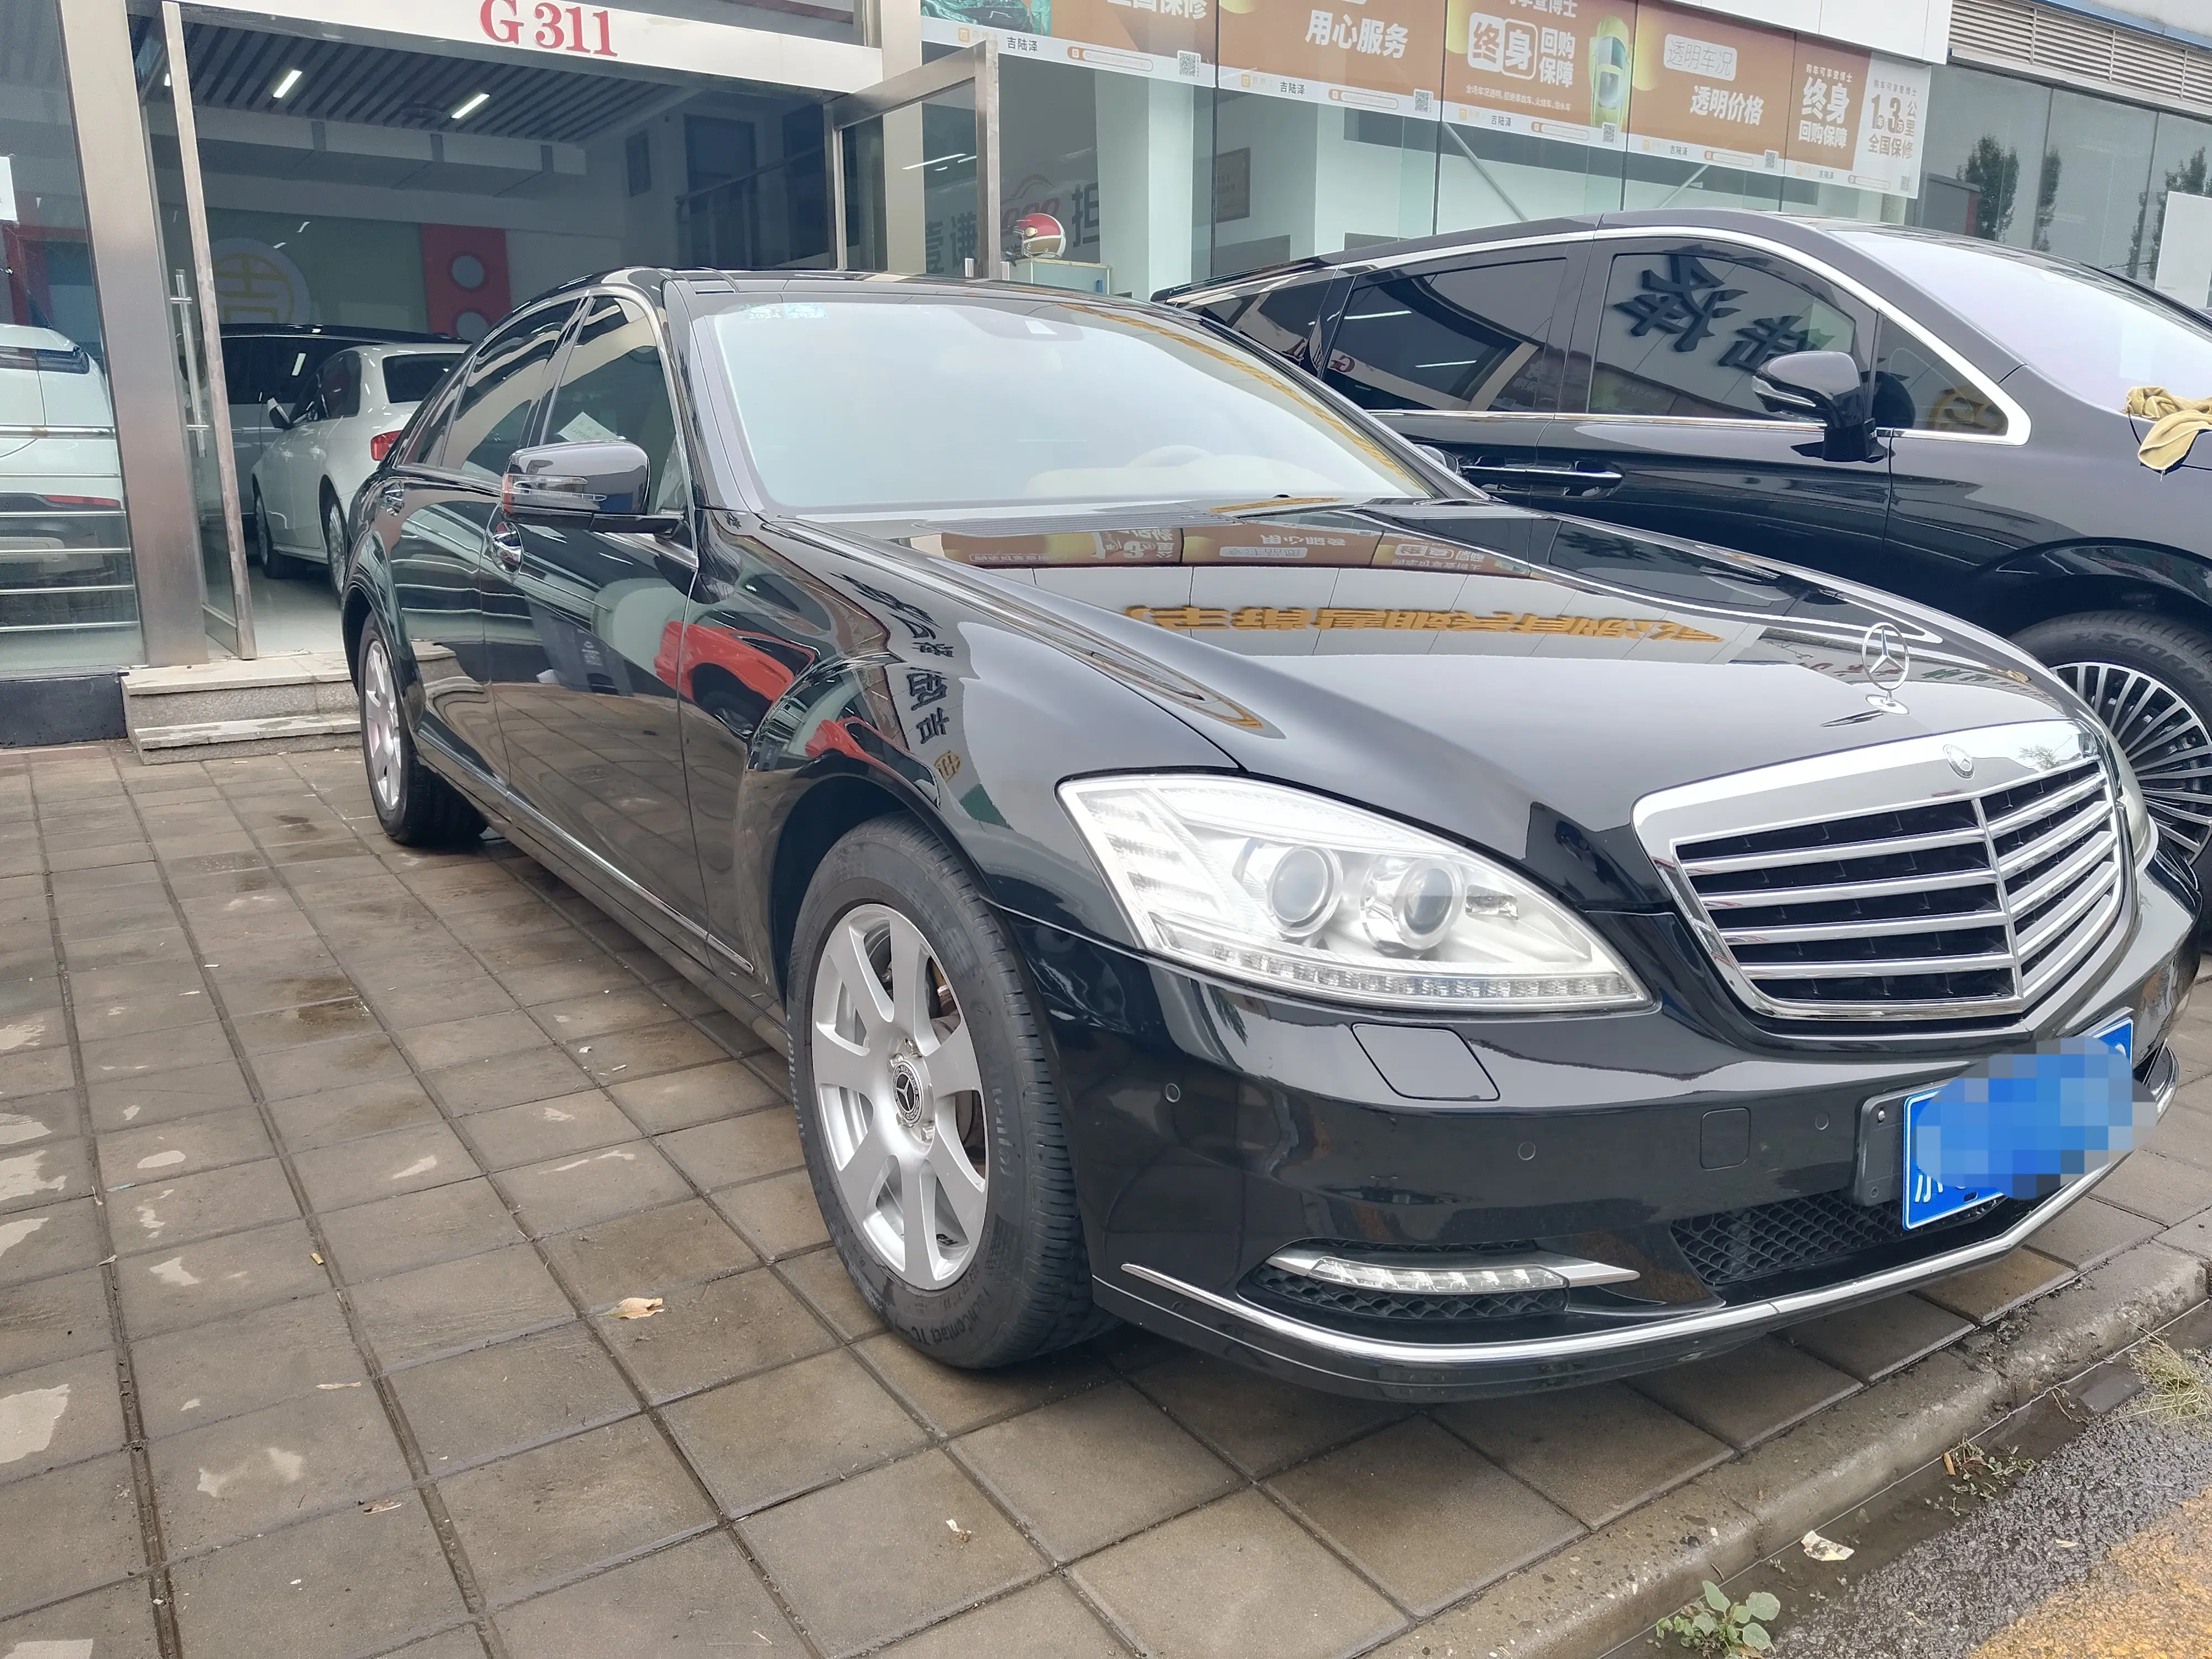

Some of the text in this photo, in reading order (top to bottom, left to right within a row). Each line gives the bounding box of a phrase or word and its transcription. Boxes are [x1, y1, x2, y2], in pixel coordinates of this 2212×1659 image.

[480, 0, 618, 57] G 311
[1006, 36, 1038, 53] 吉陆泽
[1305, 9, 1408, 59] 用心服务
[1472, 21, 1533, 71] 终身
[1540, 27, 1576, 60] 回购
[1538, 57, 1574, 87] 保障
[1667, 39, 1734, 77] 透明车况
[1279, 81, 1306, 95] 吉陆泽
[1689, 85, 1765, 126] 透明价格
[1802, 76, 1850, 124] 终身
[1798, 119, 1848, 148] 回购保障
[1868, 133, 1914, 160] 全国保修
